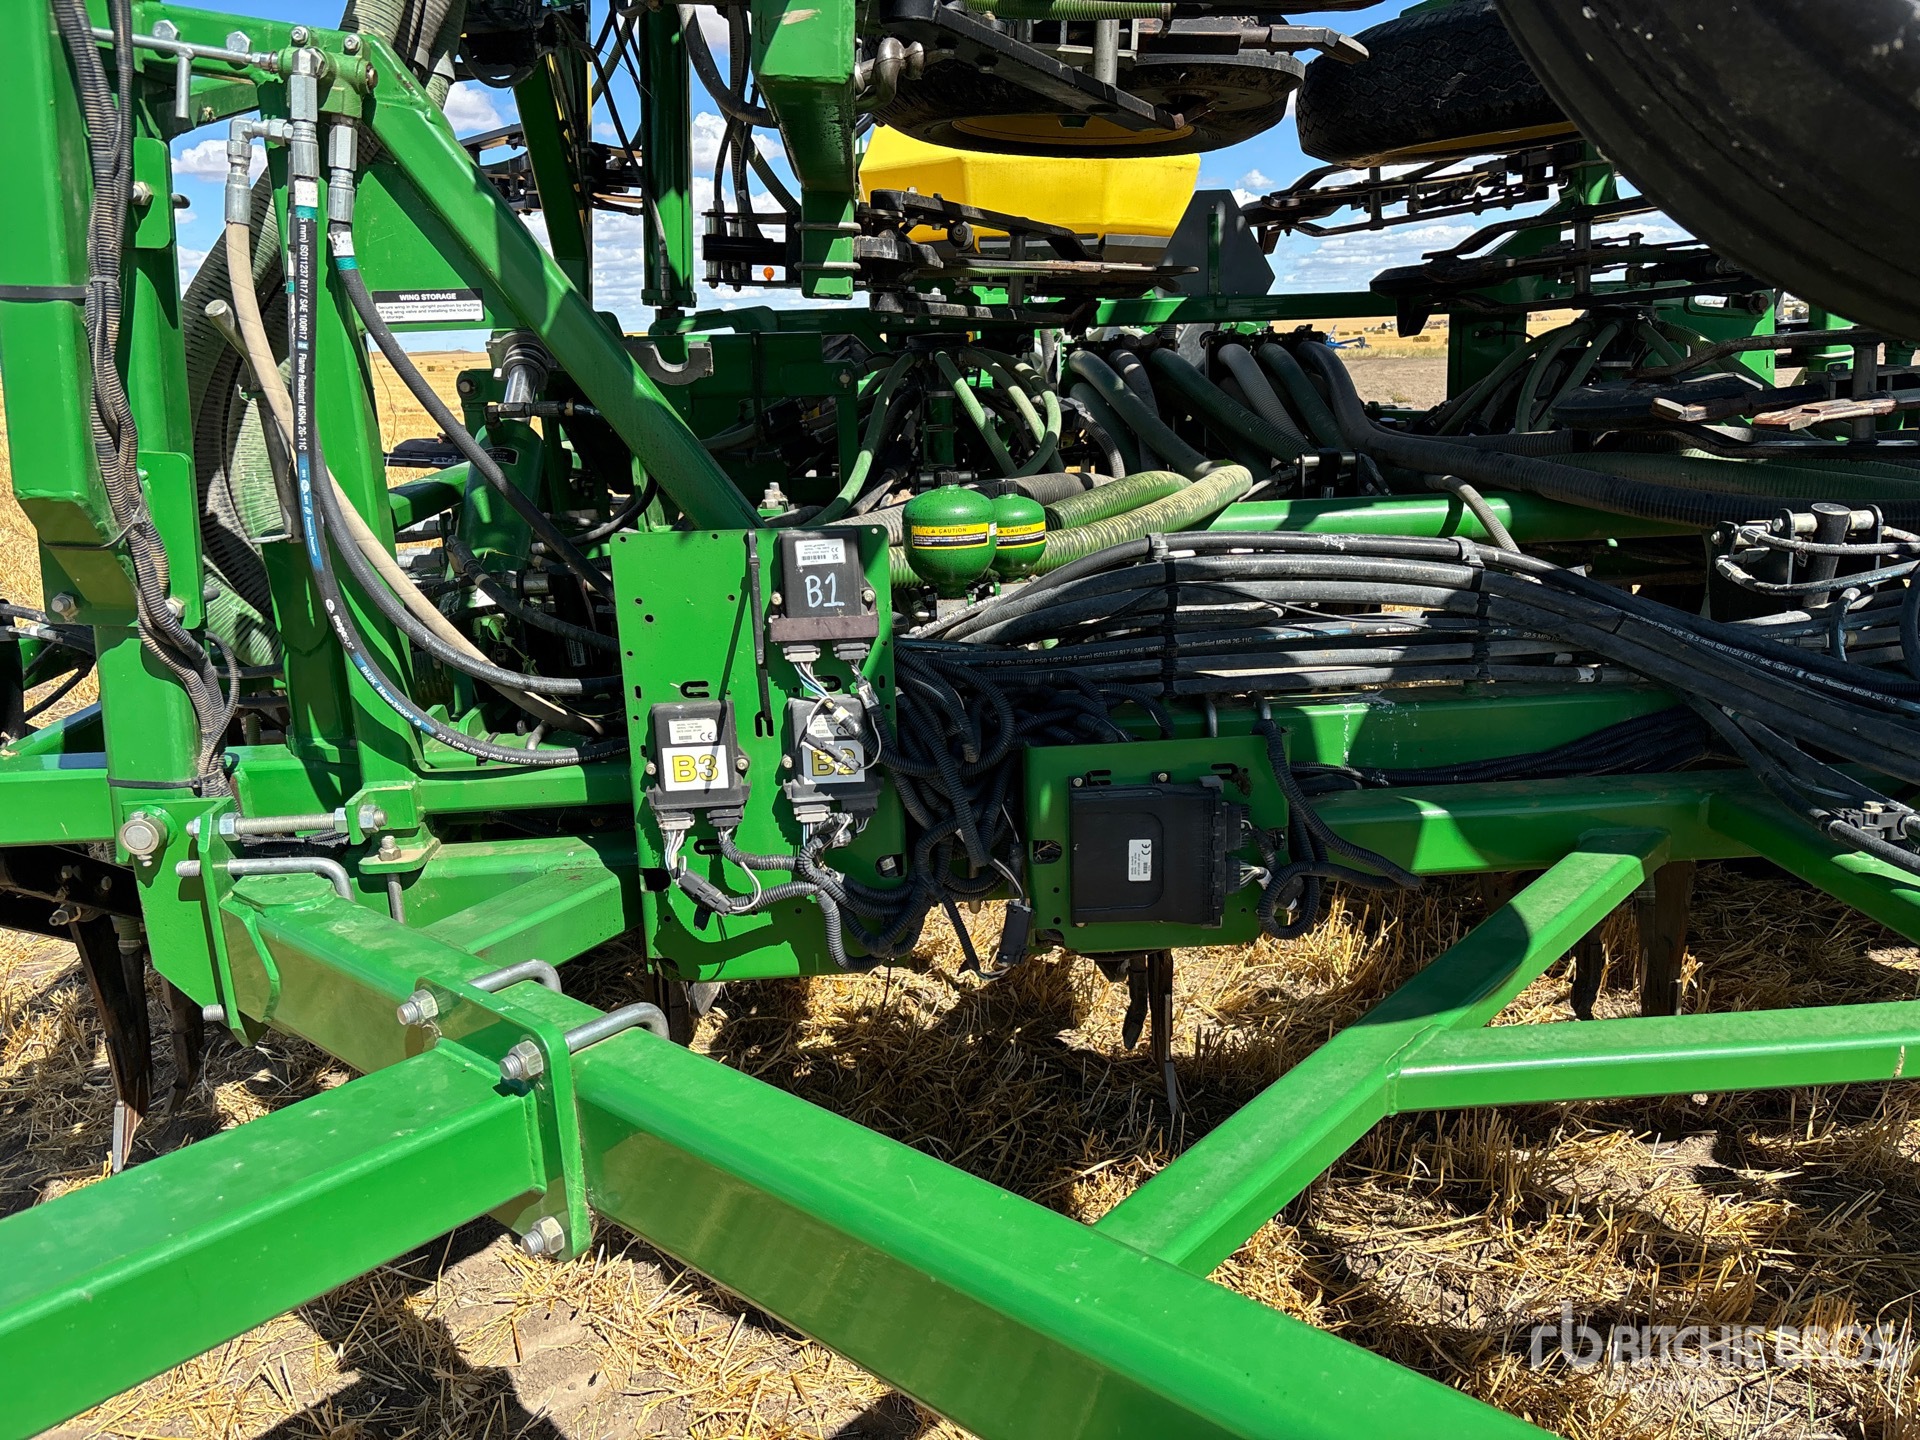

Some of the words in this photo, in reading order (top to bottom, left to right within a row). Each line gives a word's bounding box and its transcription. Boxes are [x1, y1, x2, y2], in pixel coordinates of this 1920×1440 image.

[299, 244, 309, 278] ISO11237
[299, 279, 309, 295] R17
[298, 299, 309, 314] SAE
[298, 316, 308, 340] 100R17
[298, 353, 308, 373] Flame
[297, 374, 307, 404] Resistant
[297, 405, 307, 425] MSHA
[1006, 526, 1032, 534] CAUTION
[804, 572, 845, 608] B1
[360, 665, 378, 687] 8M3K
[1805, 673, 1825, 684] Flame
[1852, 686, 1873, 698] MSHA
[672, 753, 719, 783] B3
